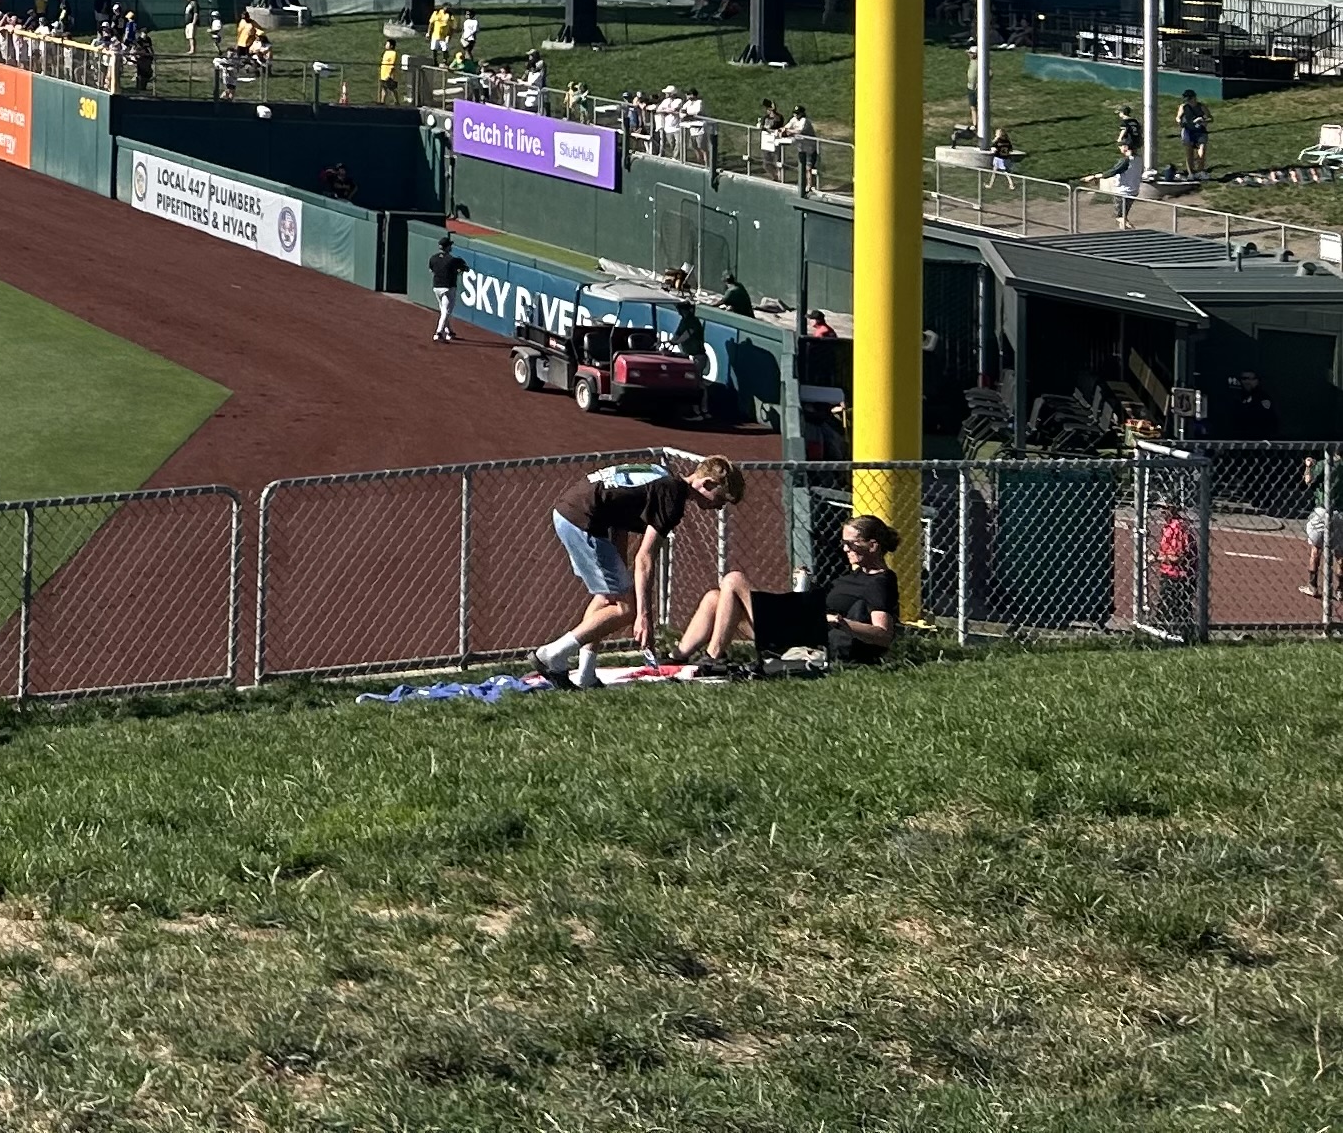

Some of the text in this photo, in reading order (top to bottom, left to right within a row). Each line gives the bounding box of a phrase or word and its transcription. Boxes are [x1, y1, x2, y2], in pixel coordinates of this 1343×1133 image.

[0, 105, 26, 128] service
[463, 117, 545, 157] Catch it live.
[559, 141, 594, 163] StubHub
[157, 167, 265, 220] LOCAL 447 PLUMBERS,
[156, 193, 257, 242] PIPEFITTERS & HVACR
[460, 269, 511, 318] SKY
